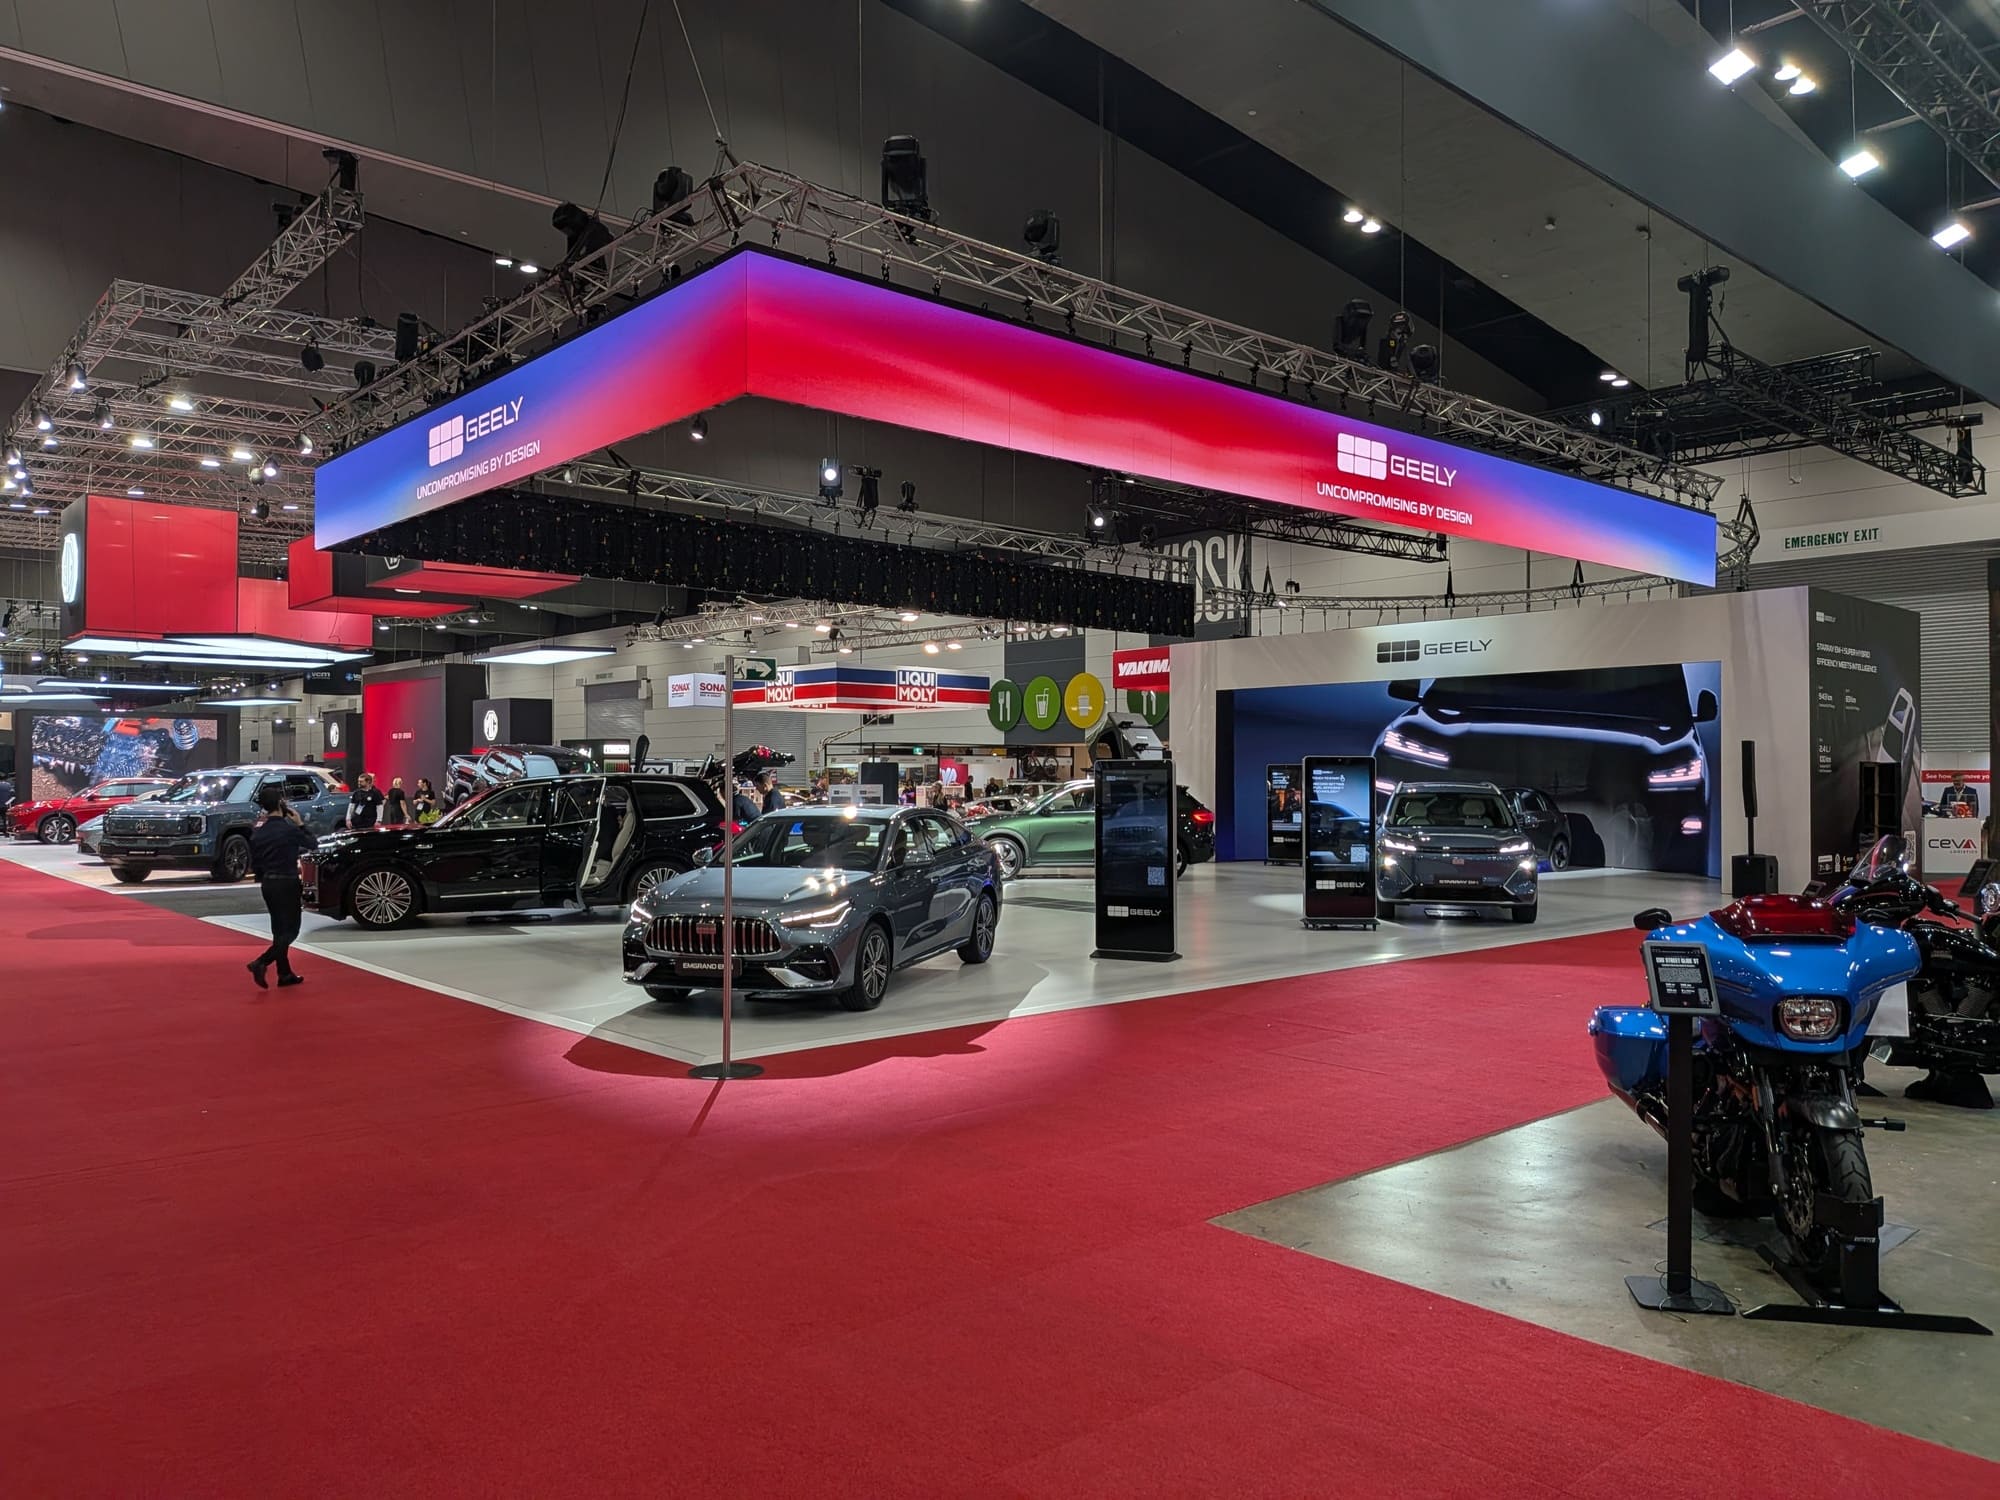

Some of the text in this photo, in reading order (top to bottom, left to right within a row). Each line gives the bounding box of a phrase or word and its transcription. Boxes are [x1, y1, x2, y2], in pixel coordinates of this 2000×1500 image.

[466, 396, 524, 442] GEELY
[416, 440, 540, 499] UNCOMPROMISING BY DESIGN
[1390, 455, 1457, 487] GEELY
[1316, 482, 1472, 525] UNCOMPROMISING BY DESIGN
[1785, 528, 1879, 549] EMERGENCY EXIT
[1424, 639, 1493, 656] GEELY
[1118, 659, 1170, 676] YAKIM
[899, 670, 935, 686] LIQUI
[672, 682, 690, 692] SONAX
[700, 682, 727, 692] SONA
[768, 688, 793, 702] MOLY
[898, 688, 935, 702] MOLY
